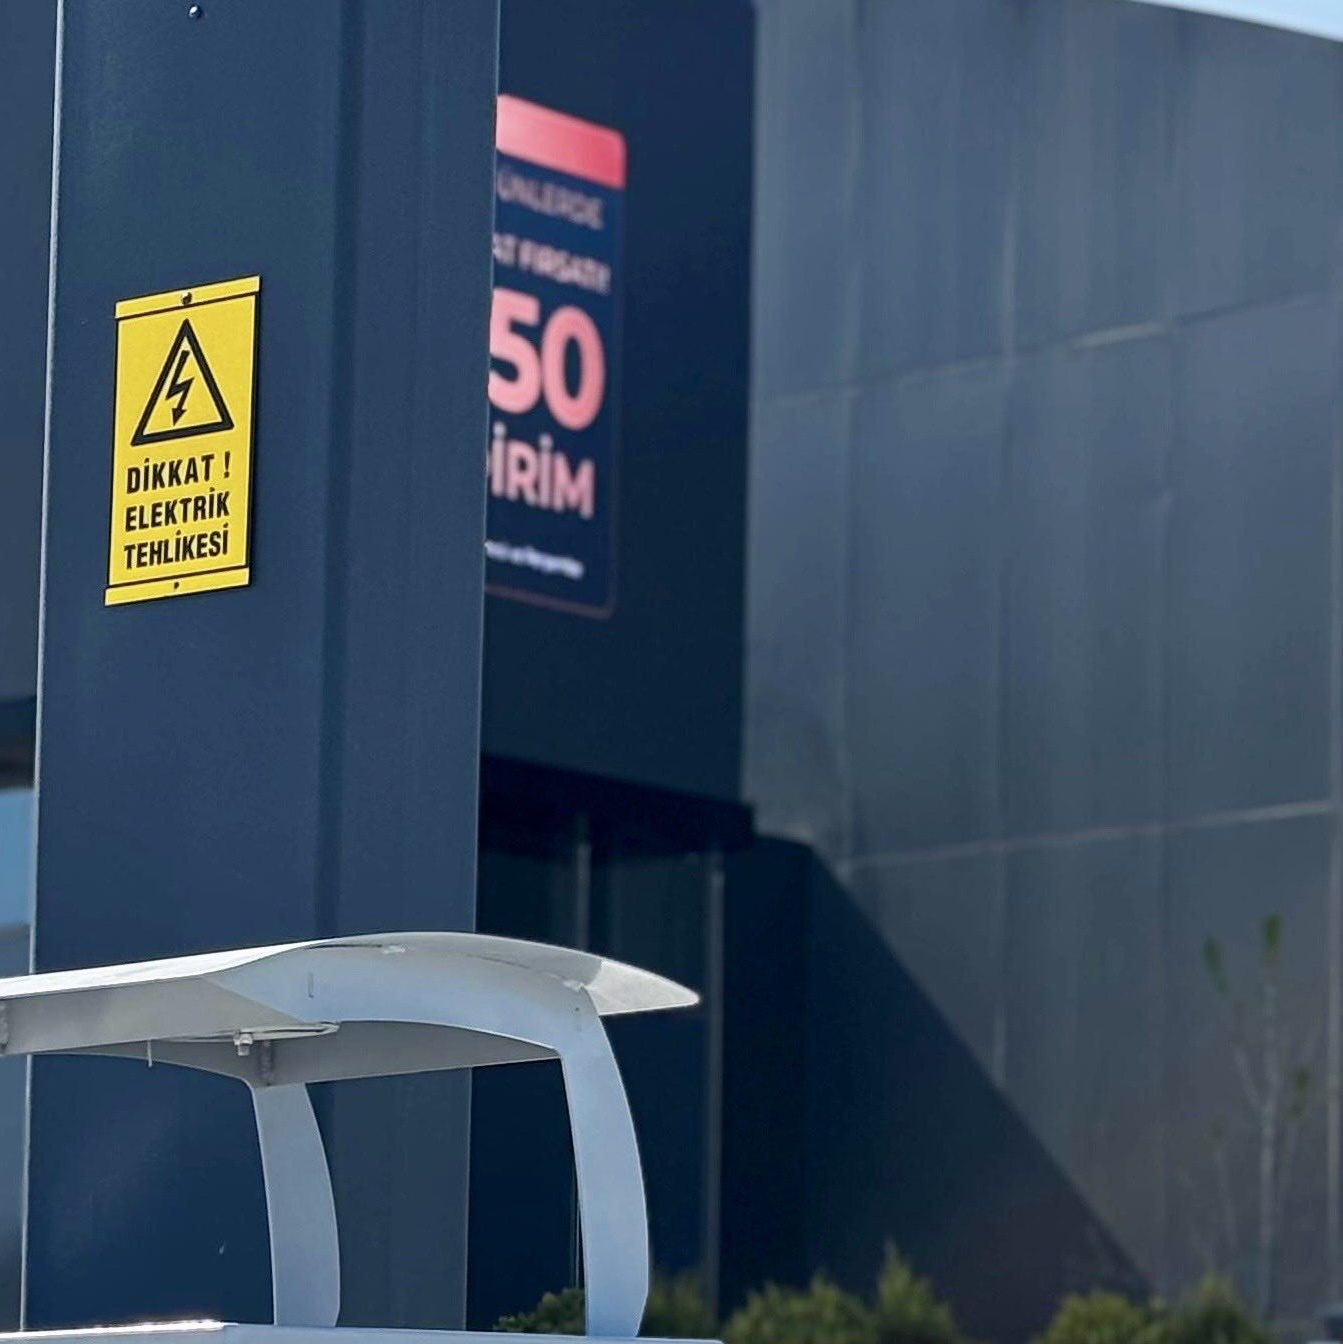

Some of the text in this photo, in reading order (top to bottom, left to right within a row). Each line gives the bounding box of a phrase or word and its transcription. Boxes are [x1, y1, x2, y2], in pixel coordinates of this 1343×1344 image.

[488, 287, 605, 430] 50
[126, 454, 215, 495] DİKKAT
[125, 487, 230, 532] ELEKTRİK
[124, 522, 229, 570] TEHLİKESİ
